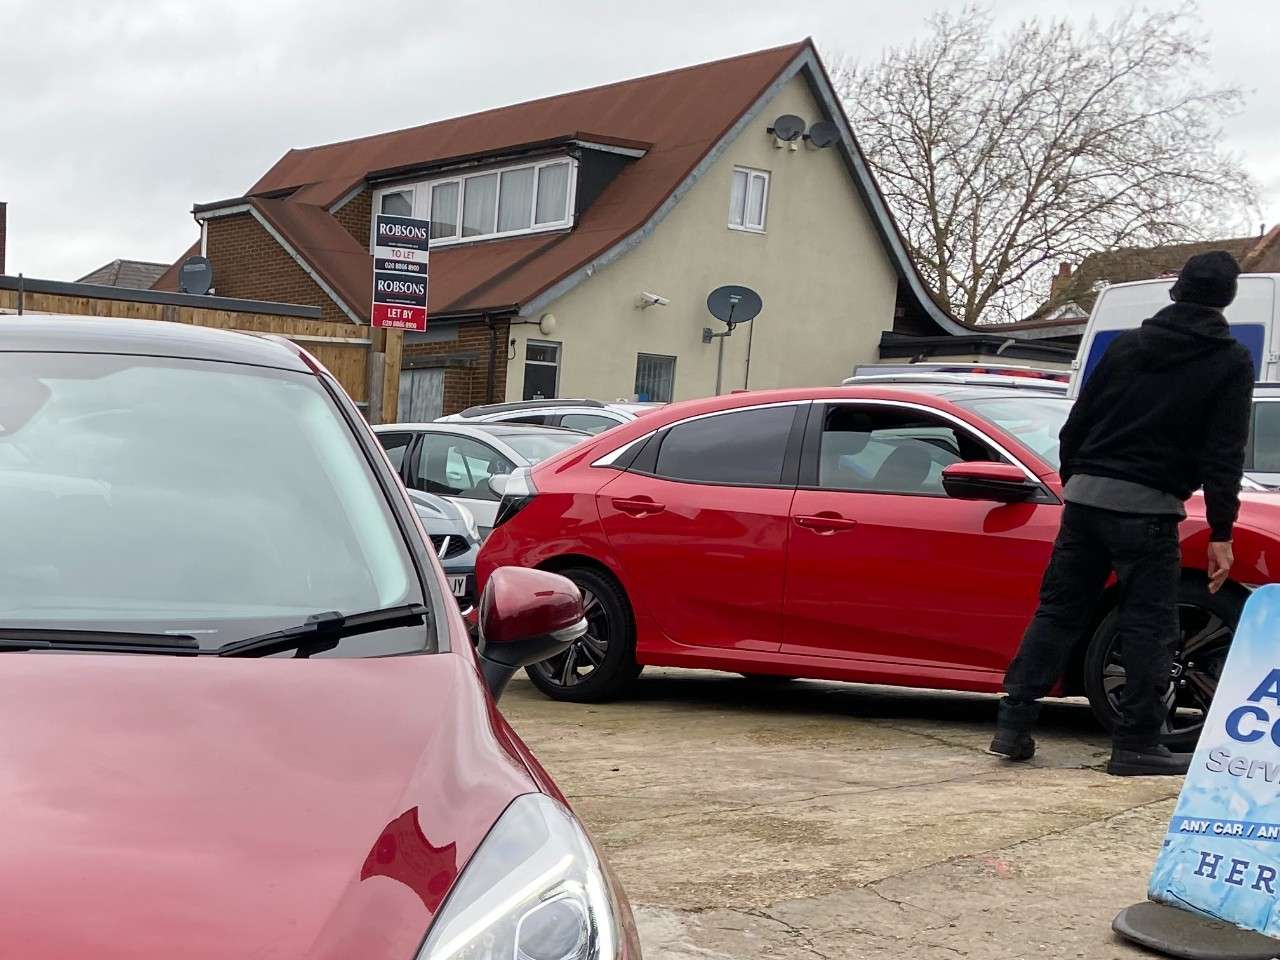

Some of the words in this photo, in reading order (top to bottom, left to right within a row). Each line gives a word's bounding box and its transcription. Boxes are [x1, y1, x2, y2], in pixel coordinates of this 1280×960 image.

[380, 223, 427, 239] ROBSONS
[391, 249, 402, 259] TO
[403, 251, 415, 260] LET
[377, 279, 425, 296] ROBSONS
[387, 308, 402, 318] LET
[402, 309, 413, 319] BY
[1180, 819, 1211, 834] ANY
[1213, 822, 1244, 837] CAR
